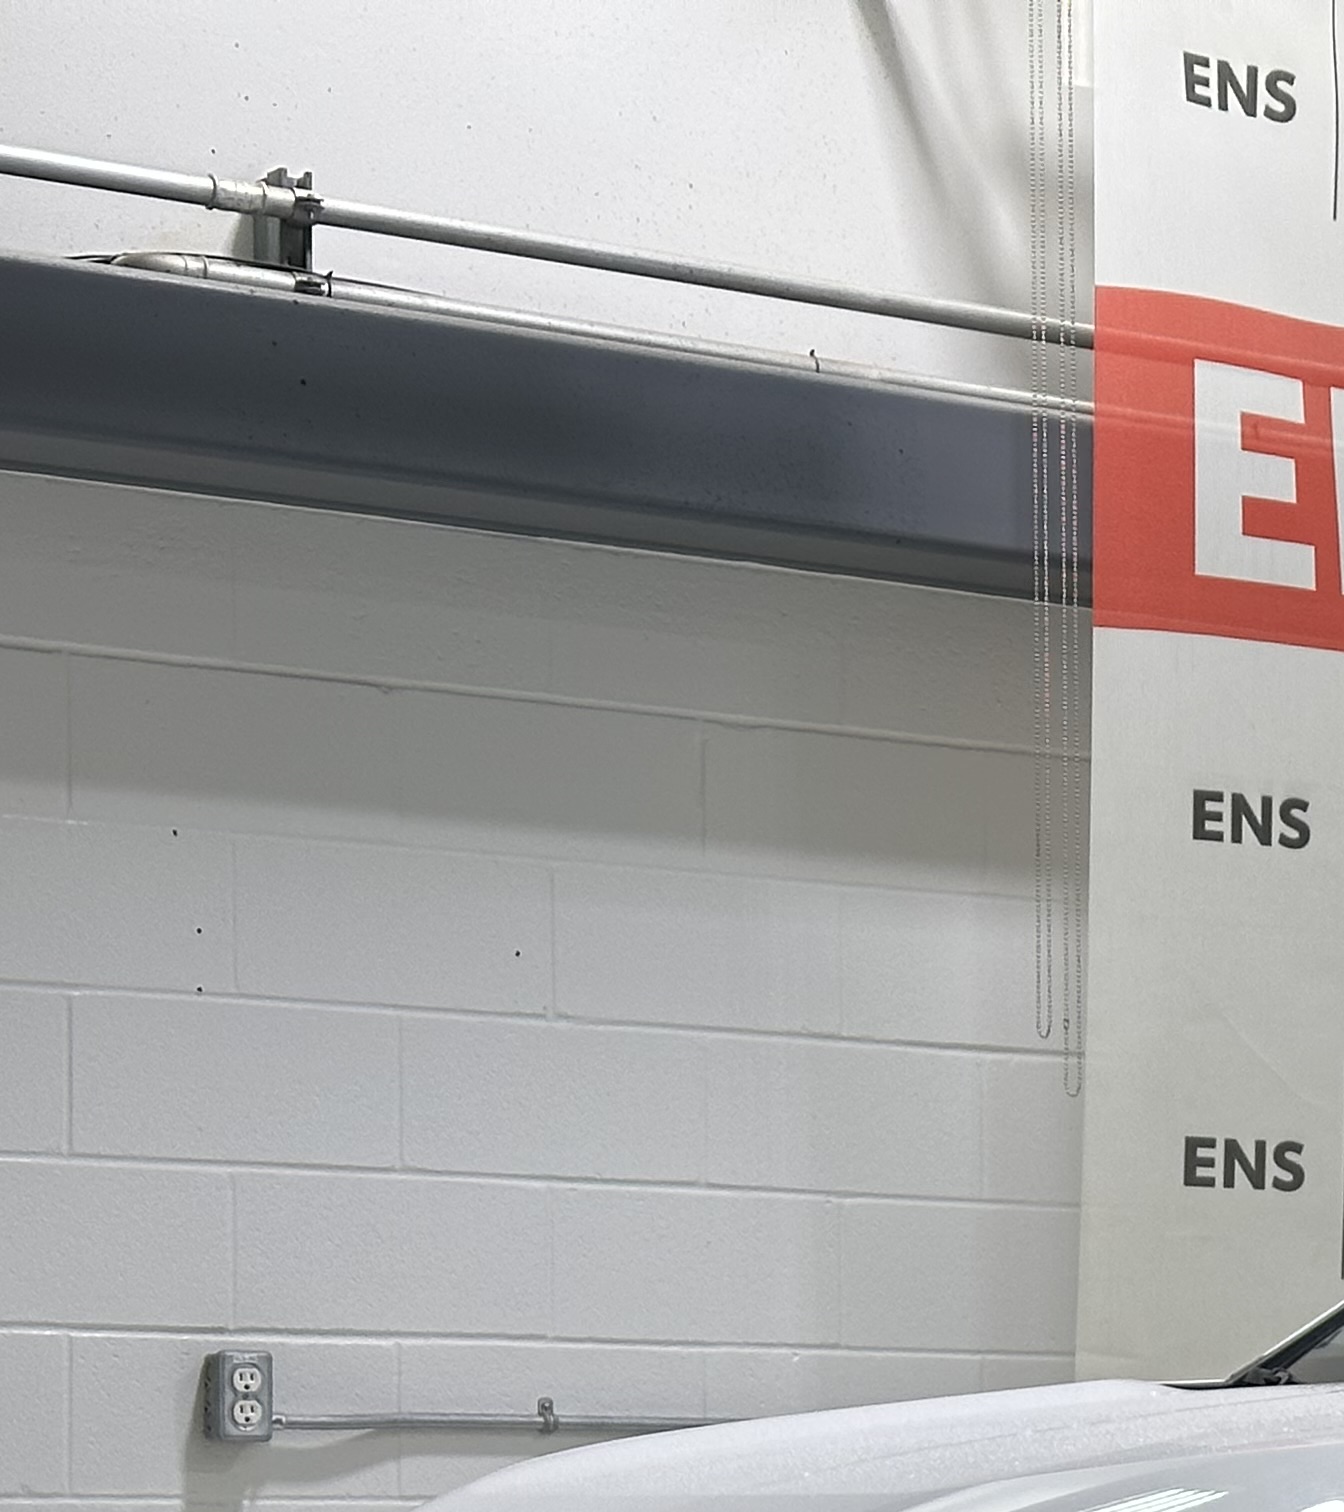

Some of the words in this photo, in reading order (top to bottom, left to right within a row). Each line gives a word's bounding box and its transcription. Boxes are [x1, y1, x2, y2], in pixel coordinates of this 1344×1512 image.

[1184, 52, 1296, 123] ENS
[1192, 790, 1310, 849] ENS
[1183, 1136, 1304, 1192] ENS
